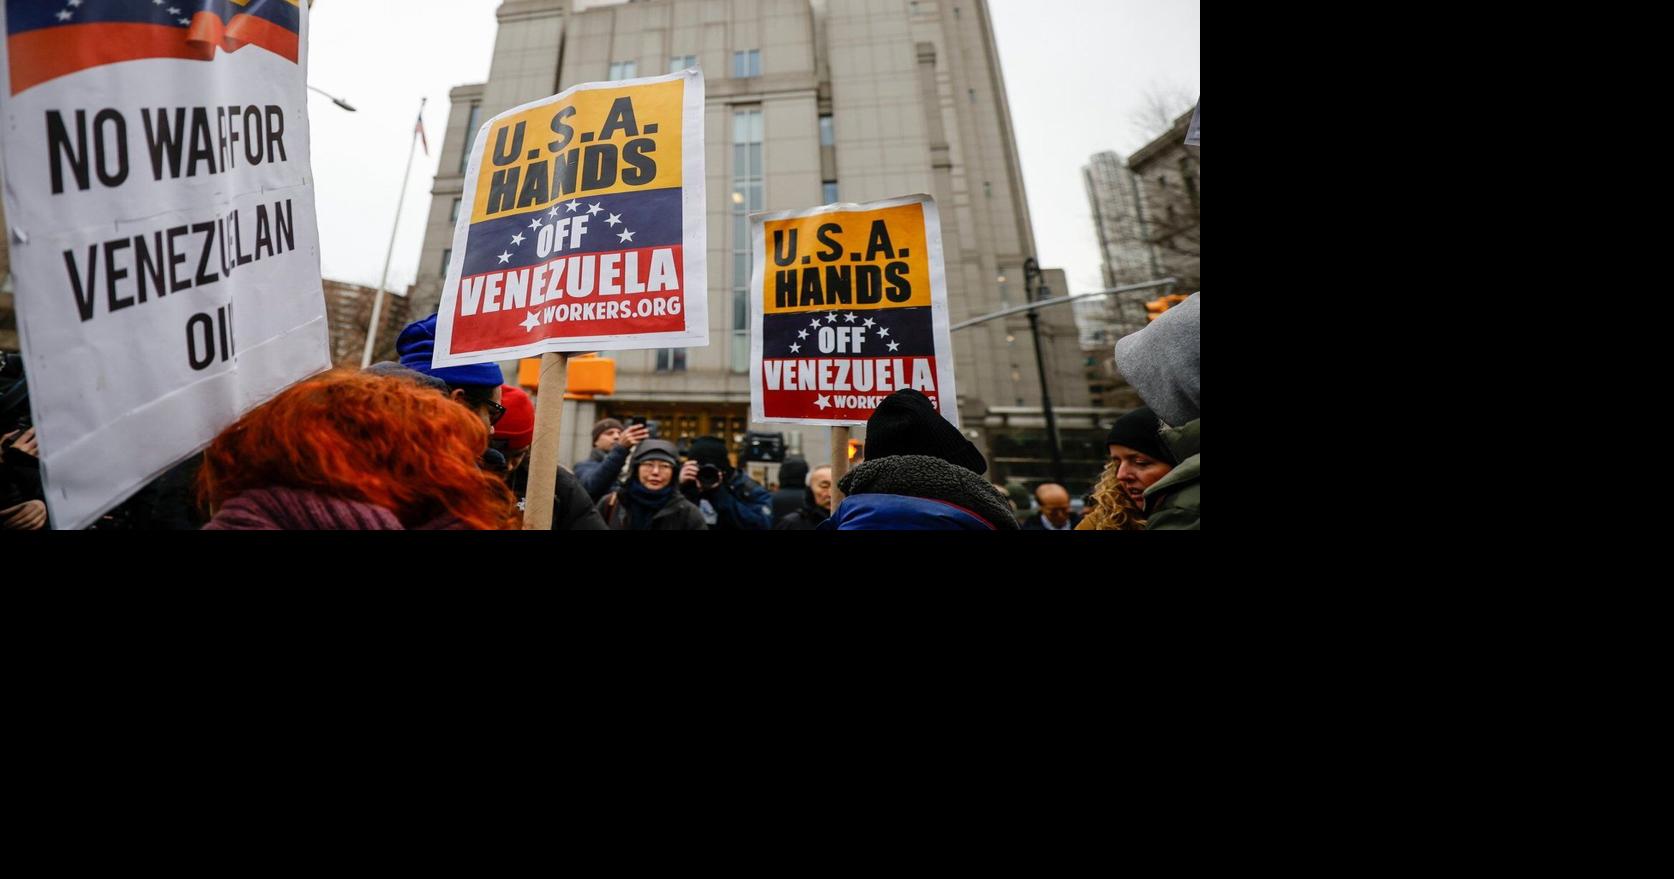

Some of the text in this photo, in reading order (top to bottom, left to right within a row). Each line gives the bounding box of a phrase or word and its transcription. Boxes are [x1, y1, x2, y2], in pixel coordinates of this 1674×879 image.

[45, 104, 287, 194] NO WAR FOR
[492, 96, 659, 167] U.S.A.
[486, 138, 657, 215] HANDS
[536, 214, 589, 258] OFF
[774, 219, 910, 267] U.S.A.
[460, 248, 680, 317] VENEZUELA
[775, 261, 912, 308] HANDS
[542, 296, 681, 324] WORKERS.ORG
[818, 326, 866, 354] OFF
[763, 358, 936, 392] VENEZUELA
